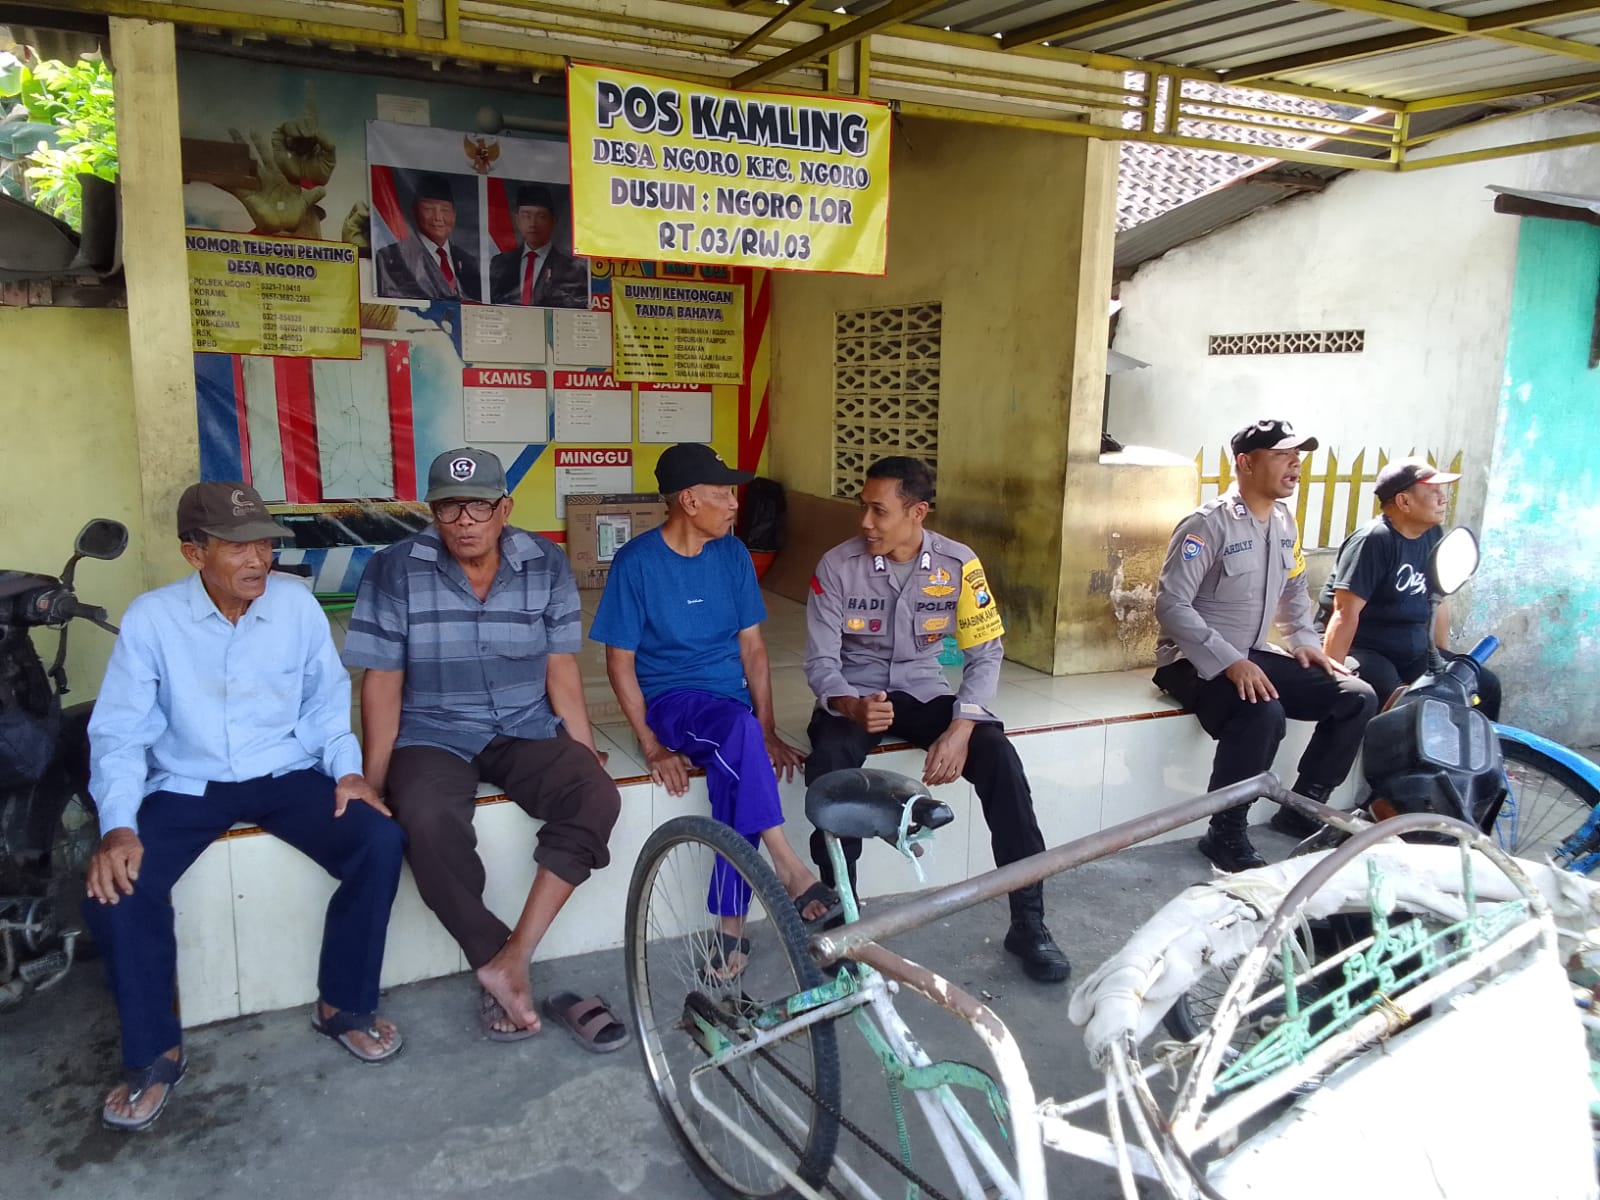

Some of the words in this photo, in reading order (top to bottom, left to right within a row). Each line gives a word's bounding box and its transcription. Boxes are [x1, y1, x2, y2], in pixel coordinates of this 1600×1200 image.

[597, 79, 682, 136] POS
[690, 94, 869, 157] KAMLING
[593, 138, 655, 167] DESA
[663, 146, 739, 176] NGORO
[746, 154, 793, 182] KEC.
[800, 160, 870, 189] NGORO
[611, 178, 695, 211] DUSUN
[716, 188, 800, 220] NGORO
[809, 197, 853, 225] LOR
[186, 236, 240, 253] NOMOR
[243, 240, 295, 258] TELPON
[298, 245, 354, 263] PENTING
[227, 260, 261, 275] DESA
[265, 263, 317, 279] NGORO
[625, 285, 661, 300] BUNYI
[662, 287, 733, 304] KENTONGAN
[635, 304, 674, 319] TANDA
[677, 306, 723, 321] BAHAYA
[479, 371, 532, 385] KAMIS
[560, 451, 629, 465] MINGGU
[848, 597, 885, 611] HADI
